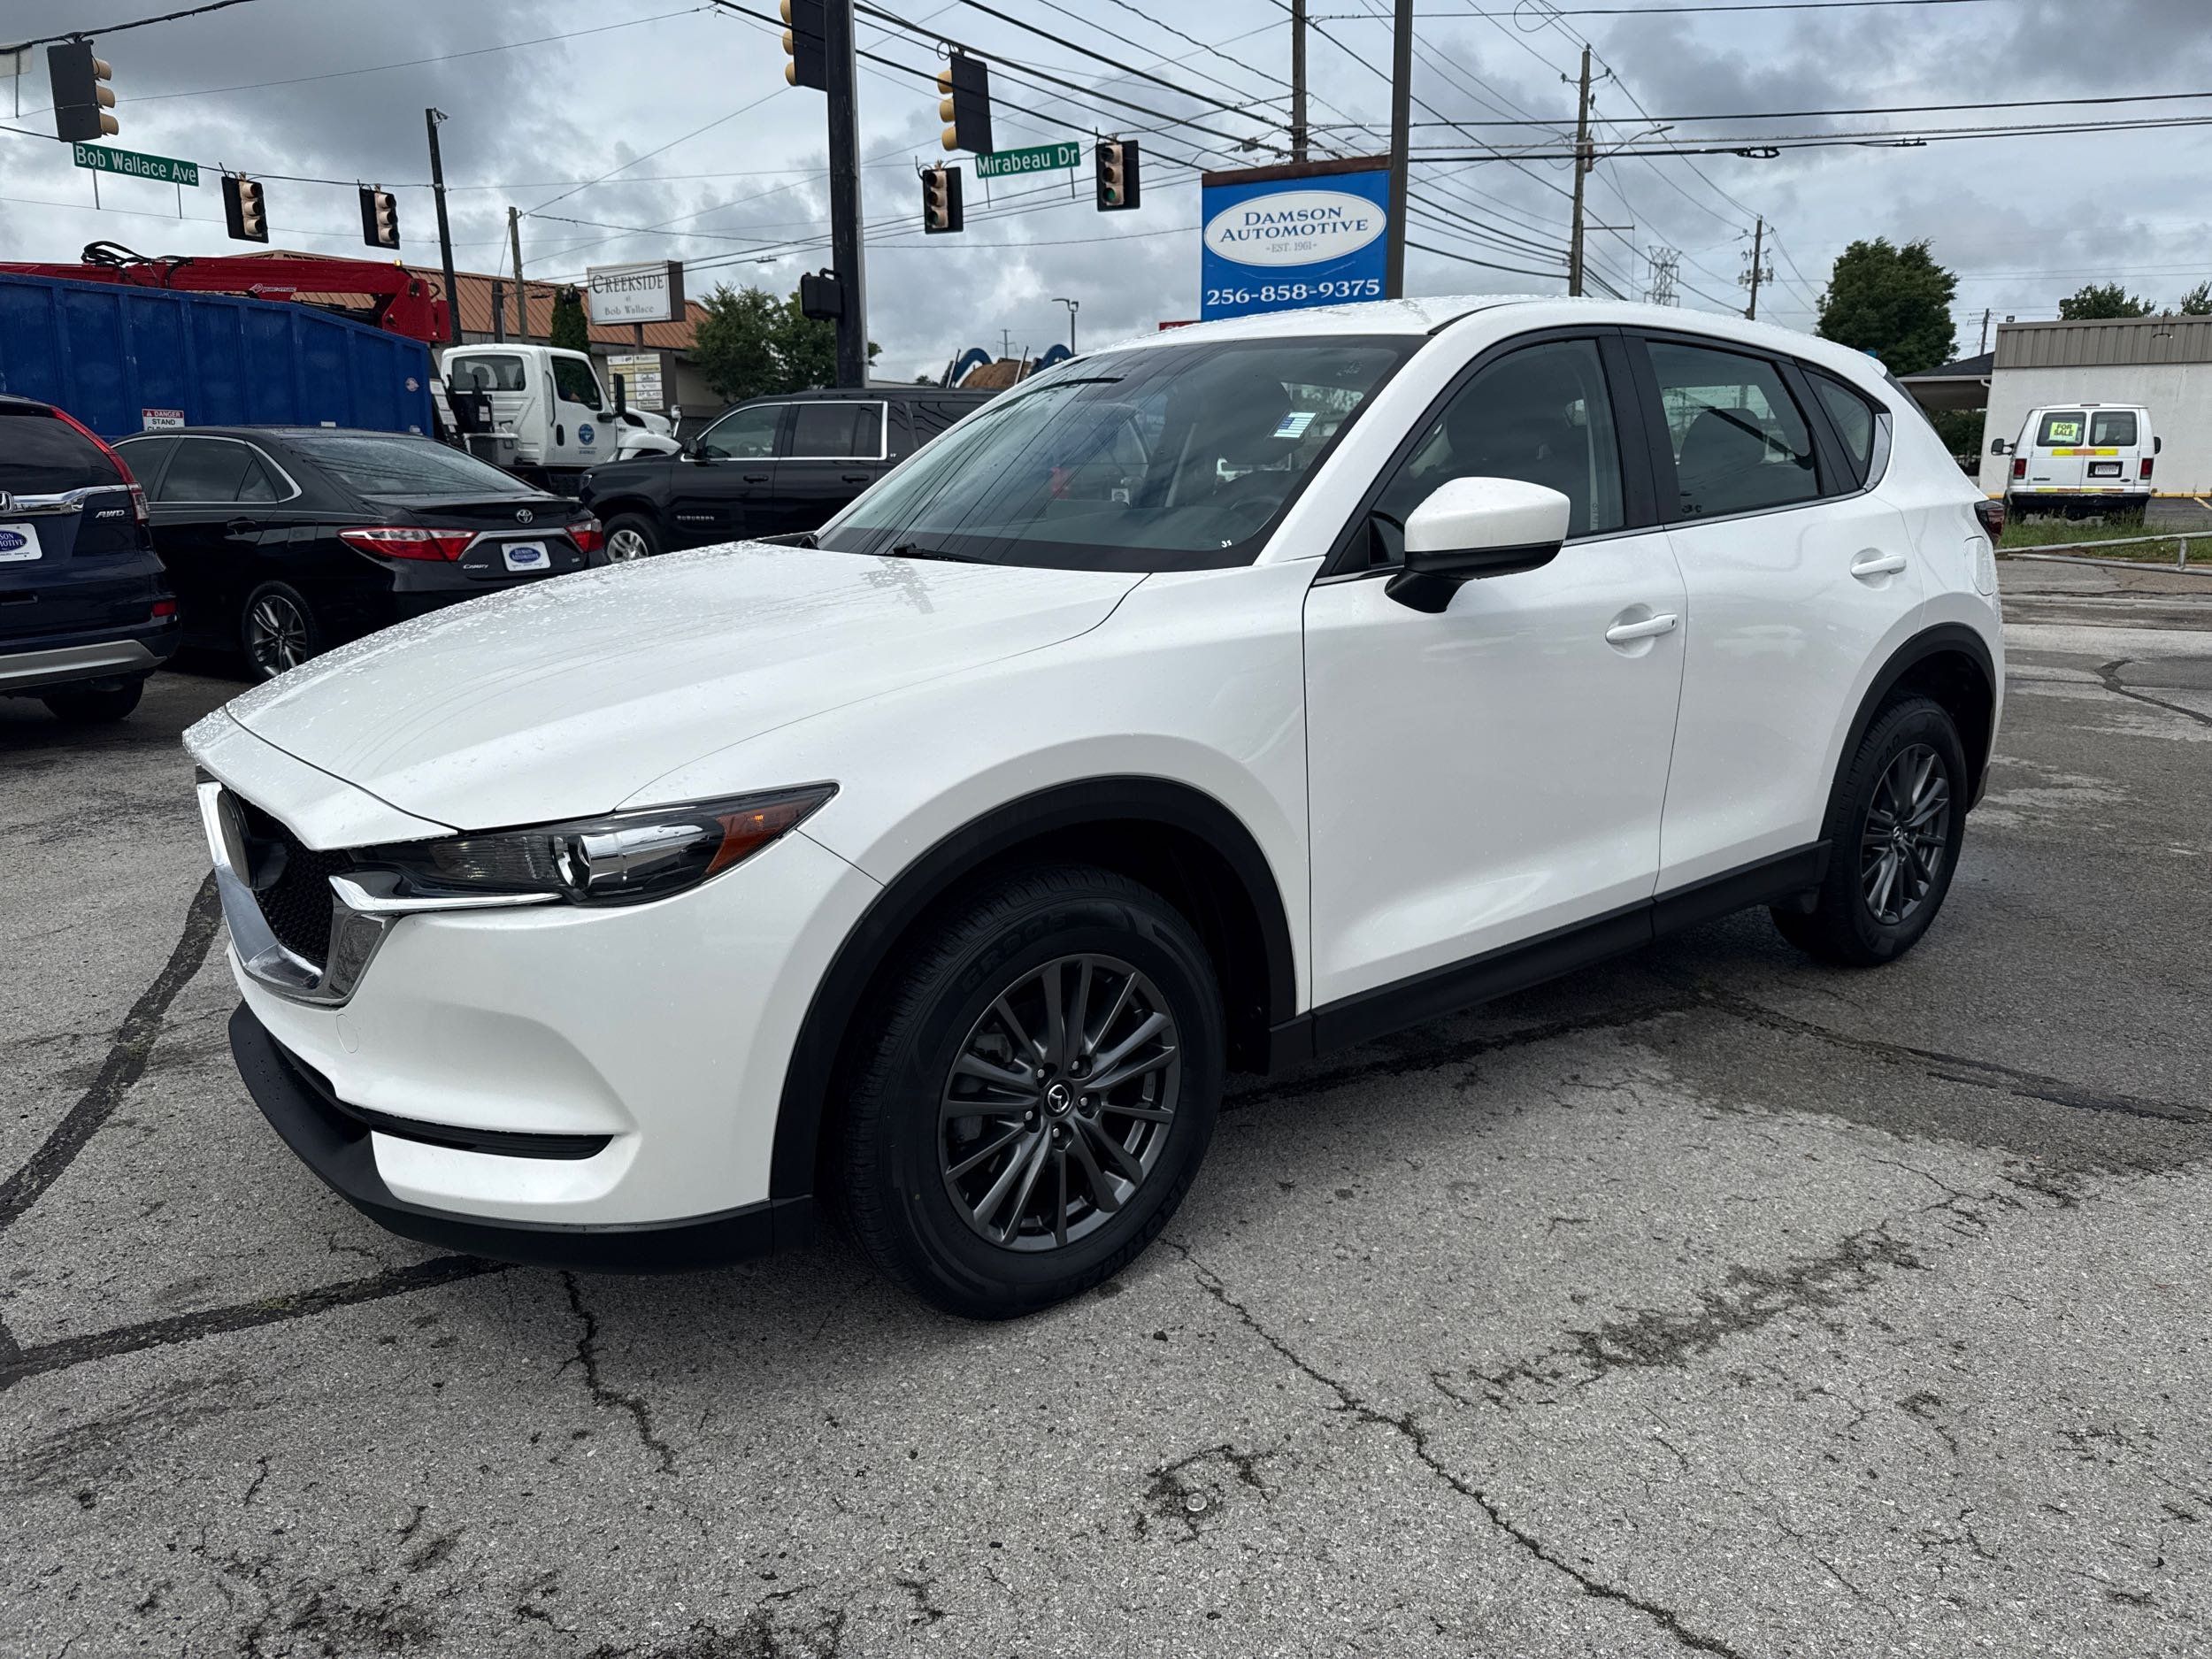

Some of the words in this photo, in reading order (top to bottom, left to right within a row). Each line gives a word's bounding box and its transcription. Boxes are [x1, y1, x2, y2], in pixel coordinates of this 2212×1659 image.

[75, 145, 106, 168] Bob
[111, 151, 167, 178] Wallace
[172, 163, 196, 183] Ave
[977, 152, 1051, 175] Mirabeau
[1057, 146, 1078, 165] Dr
[1244, 206, 1343, 227] DAMSON
[1219, 219, 1369, 242] AUTOMOTIVE
[592, 274, 664, 294] CREEKSIDE
[1206, 278, 1380, 306] 256-858-9375
[604, 306, 621, 316] Bob
[625, 304, 655, 314] Wallace
[95, 510, 125, 518] AWD
